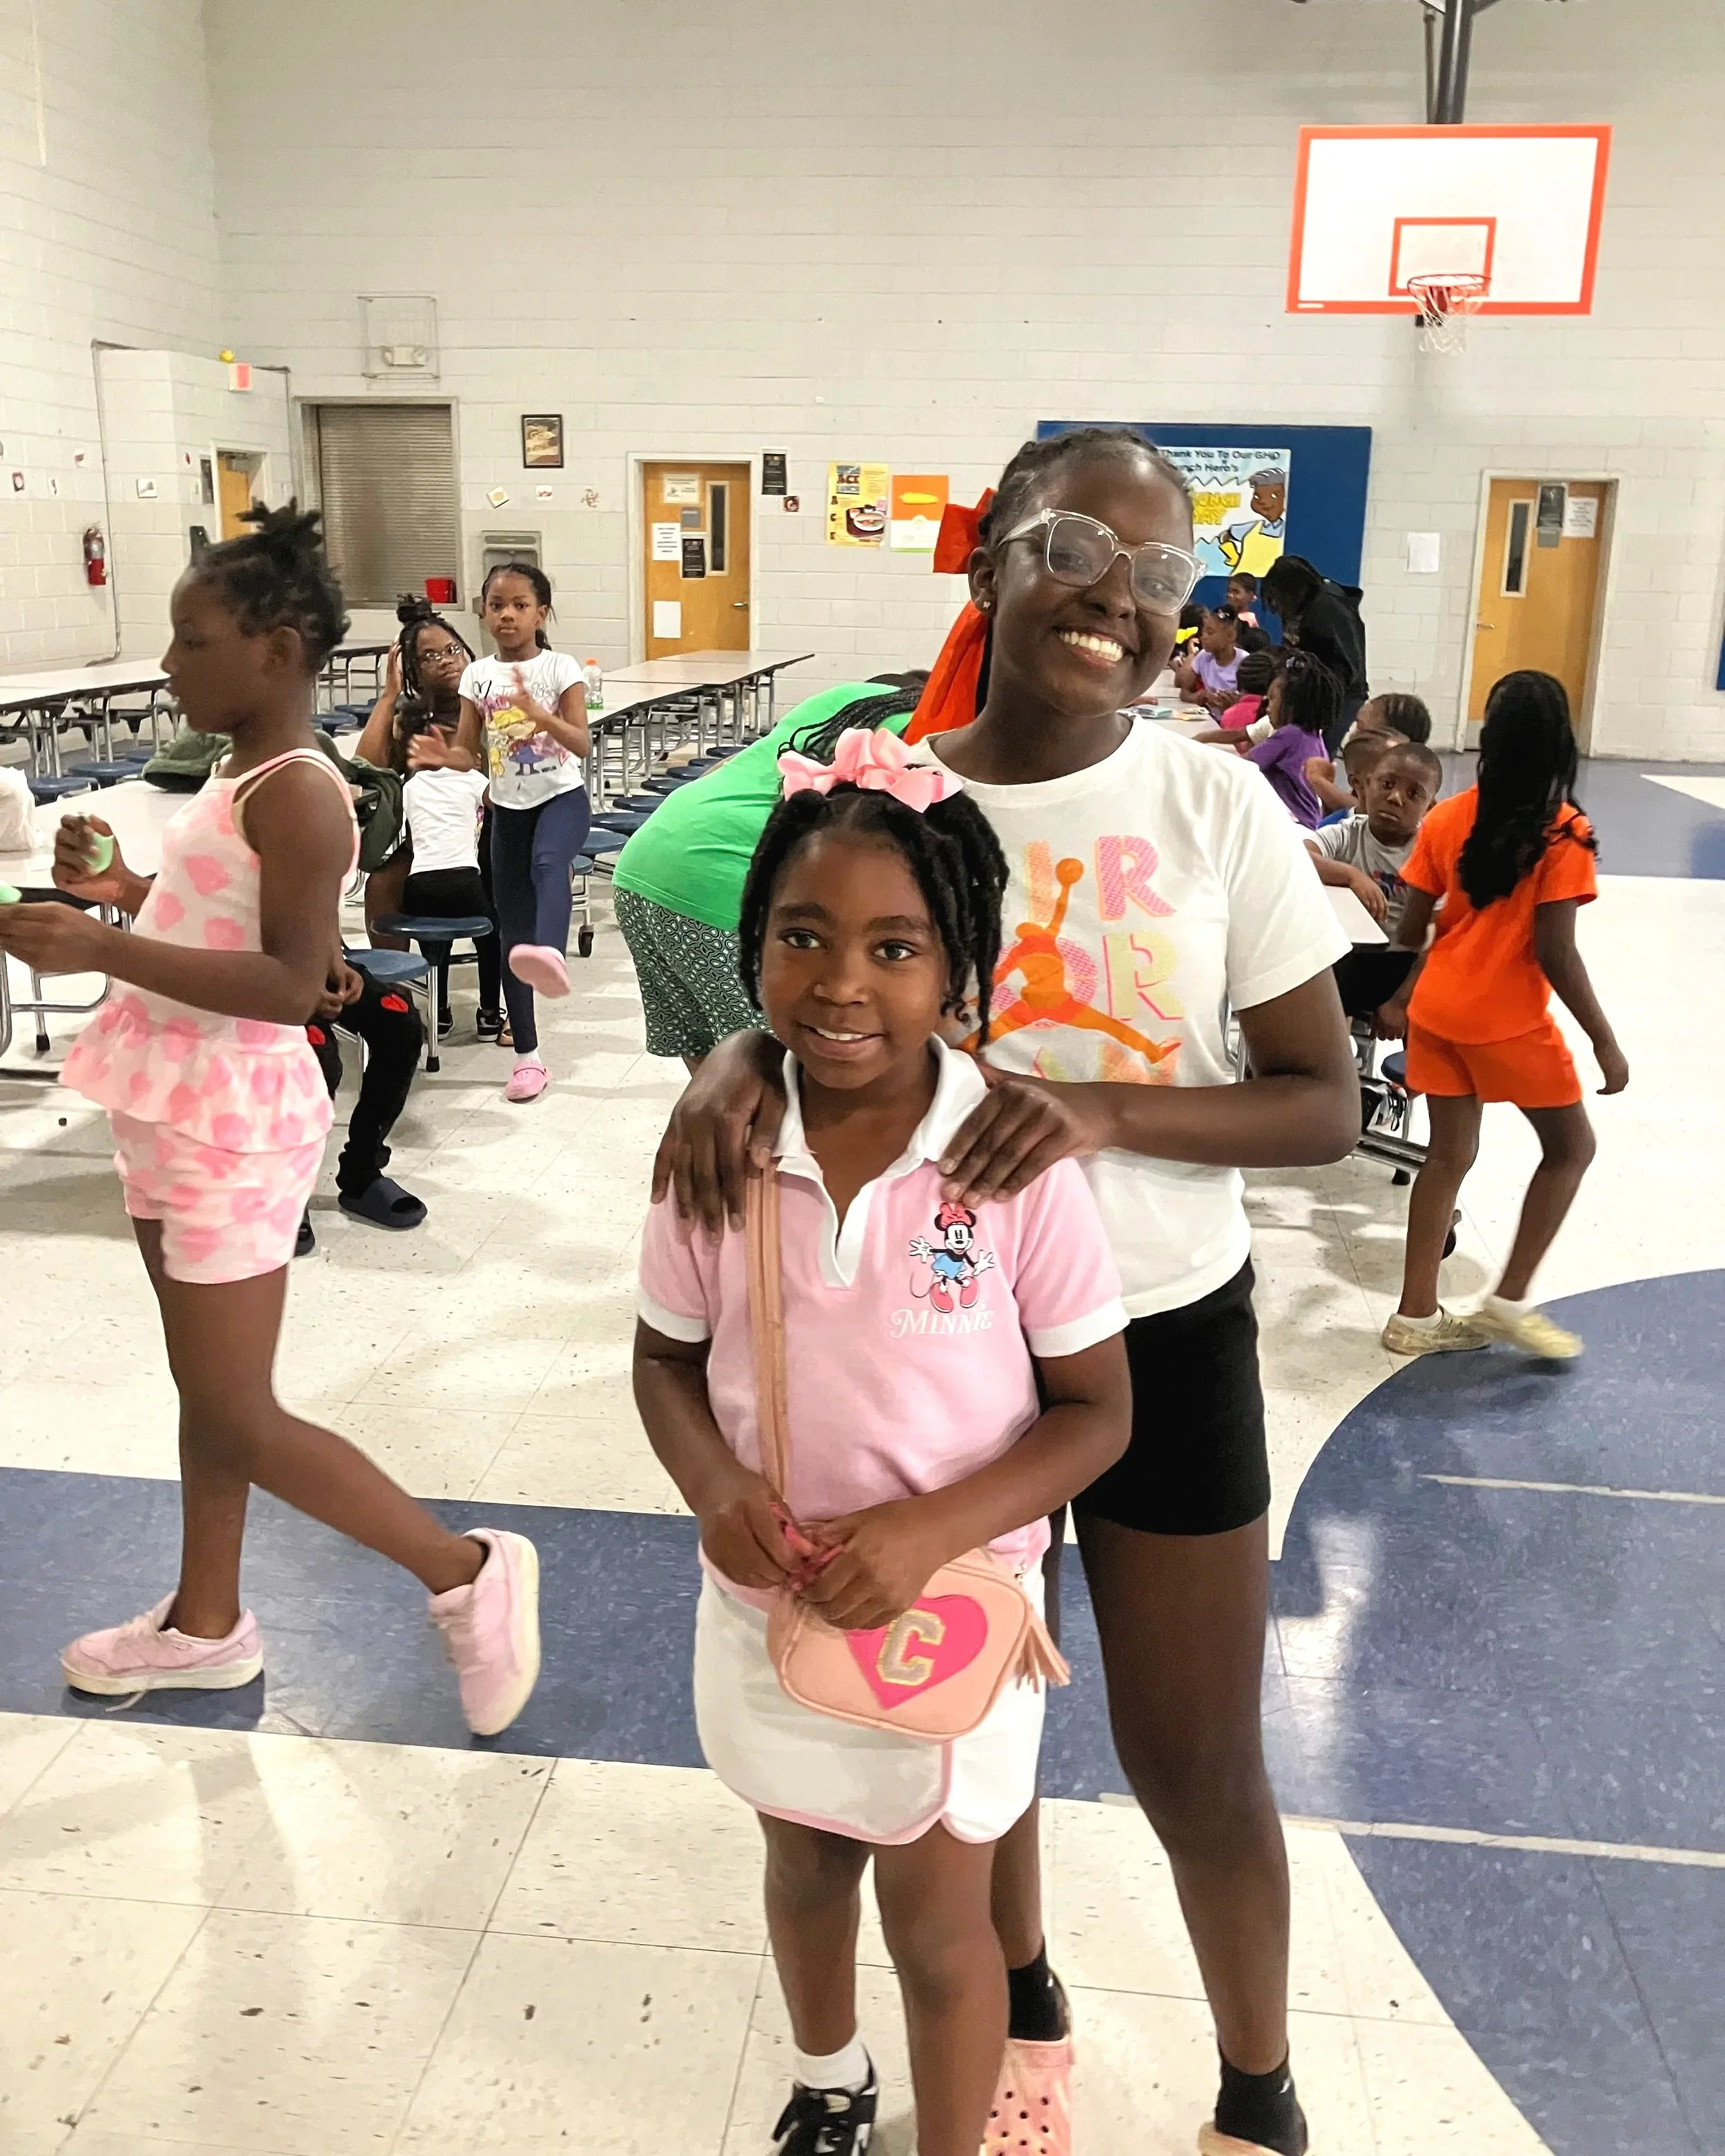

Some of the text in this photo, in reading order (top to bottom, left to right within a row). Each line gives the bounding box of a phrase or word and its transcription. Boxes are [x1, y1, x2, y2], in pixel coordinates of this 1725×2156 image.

[1194, 450, 1214, 458] You
[1217, 450, 1230, 459] To
[1023, 834, 1177, 921] IR
[876, 1609, 946, 1686] C
